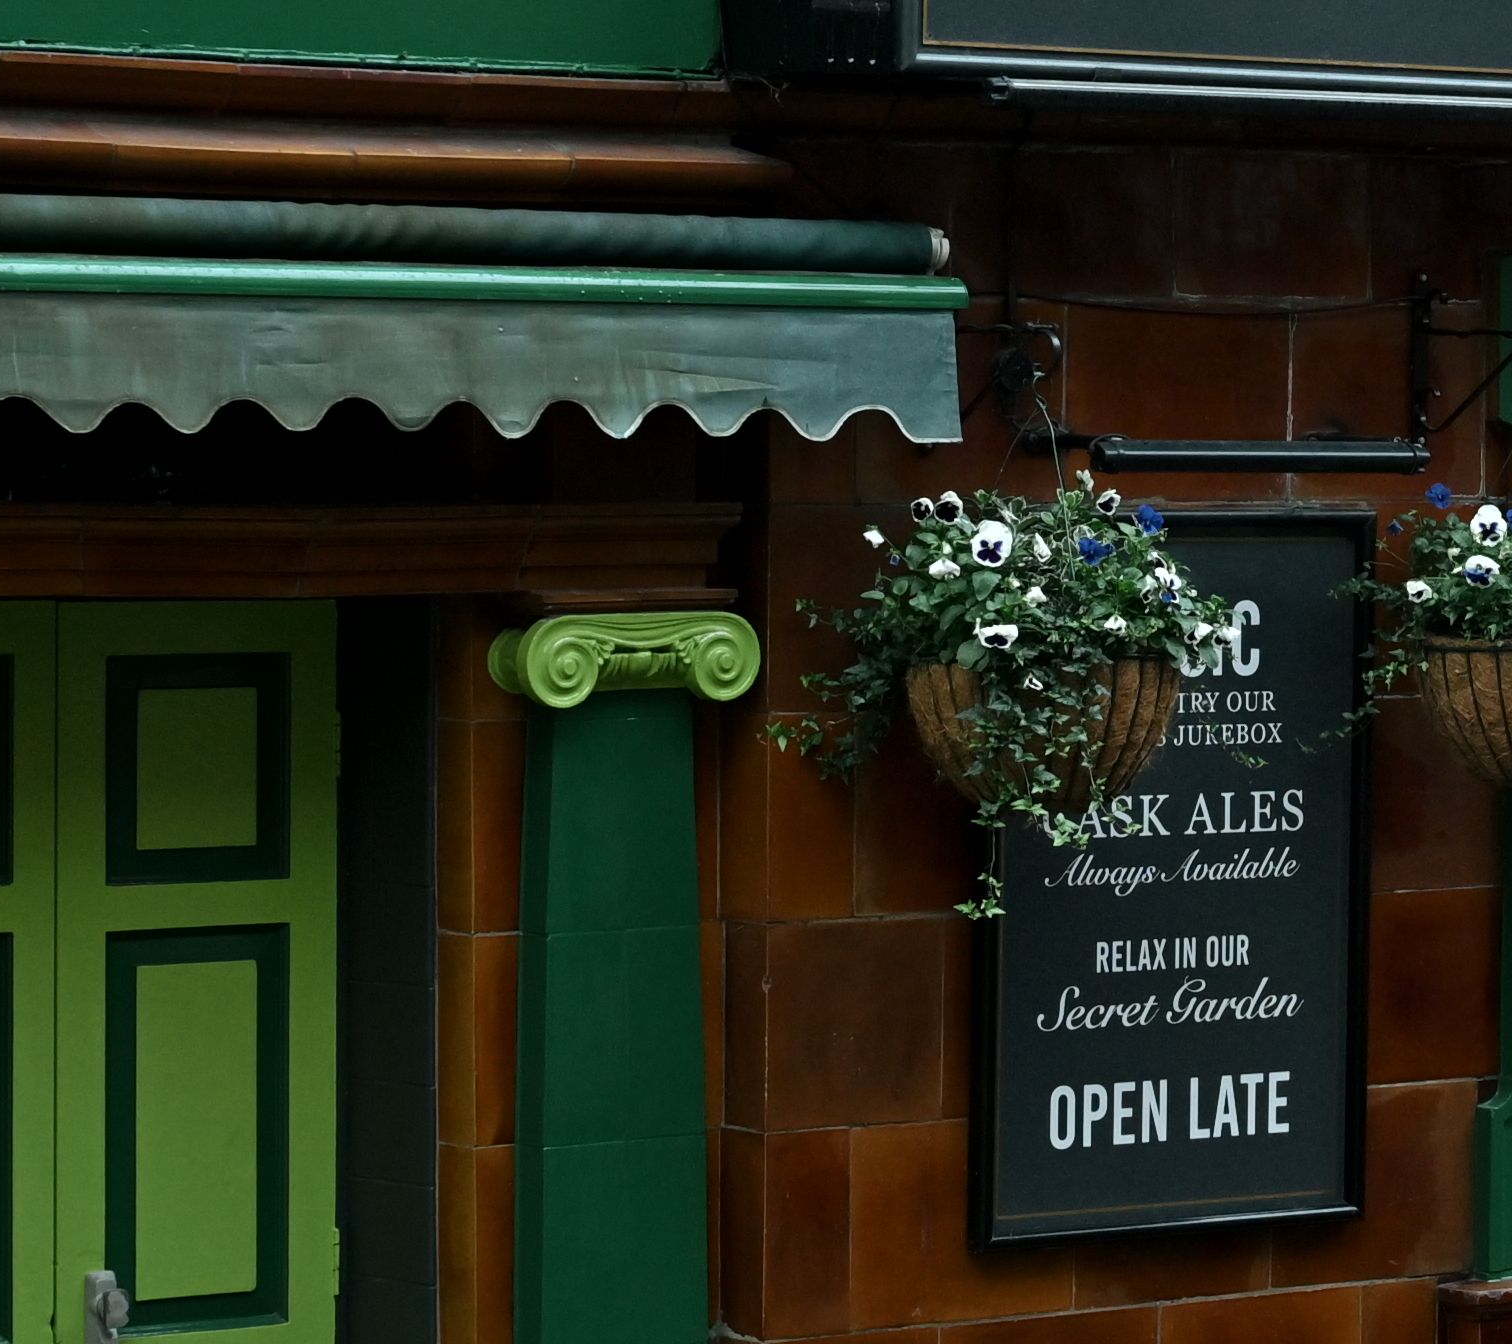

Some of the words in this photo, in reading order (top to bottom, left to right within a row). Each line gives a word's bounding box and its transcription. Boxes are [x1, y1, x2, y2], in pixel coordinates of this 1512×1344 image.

[1227, 691, 1276, 712] OUR
[1173, 722, 1283, 746] JUKEBOX
[1184, 789, 1304, 836] ALES
[1044, 853, 1161, 896] Always
[1161, 846, 1301, 883] Available
[1096, 938, 1167, 973] RELAX
[1174, 937, 1197, 969] IN
[1206, 934, 1249, 968] OUR
[1036, 985, 1160, 1032] Secret
[1166, 975, 1304, 1025] Garden
[1049, 1079, 1168, 1150] OPEN
[1189, 1070, 1290, 1140] LATE
